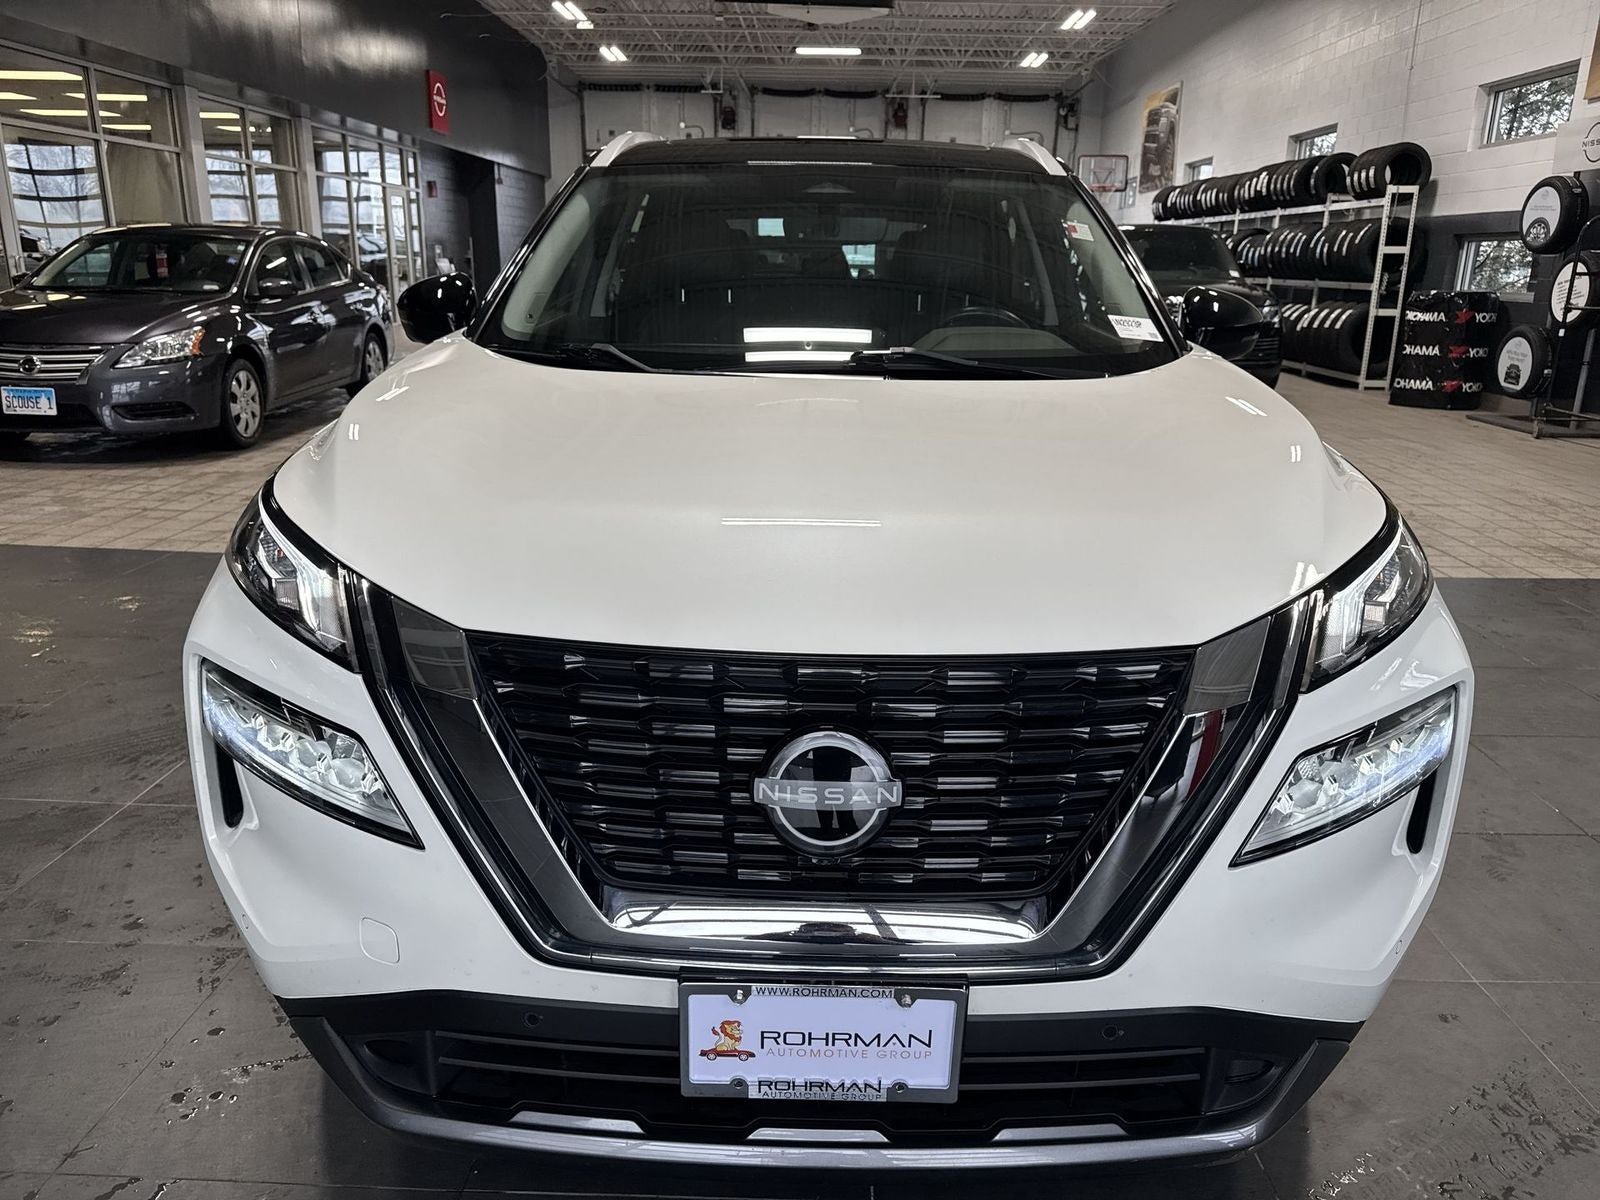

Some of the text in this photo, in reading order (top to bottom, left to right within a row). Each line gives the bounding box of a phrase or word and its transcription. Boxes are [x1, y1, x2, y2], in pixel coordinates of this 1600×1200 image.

[5, 395, 54, 410] SCOUSE 1
[758, 782, 898, 805] NISSAN
[755, 986, 893, 999] WWW.ROHRMAN.COM
[760, 1029, 932, 1049] ROHRMAN
[766, 1047, 932, 1060] AUTOMOTIVE GROUP
[757, 1079, 882, 1094] ROHRMAN
[762, 1091, 882, 1101] AUTOMOTIVE GROUP
